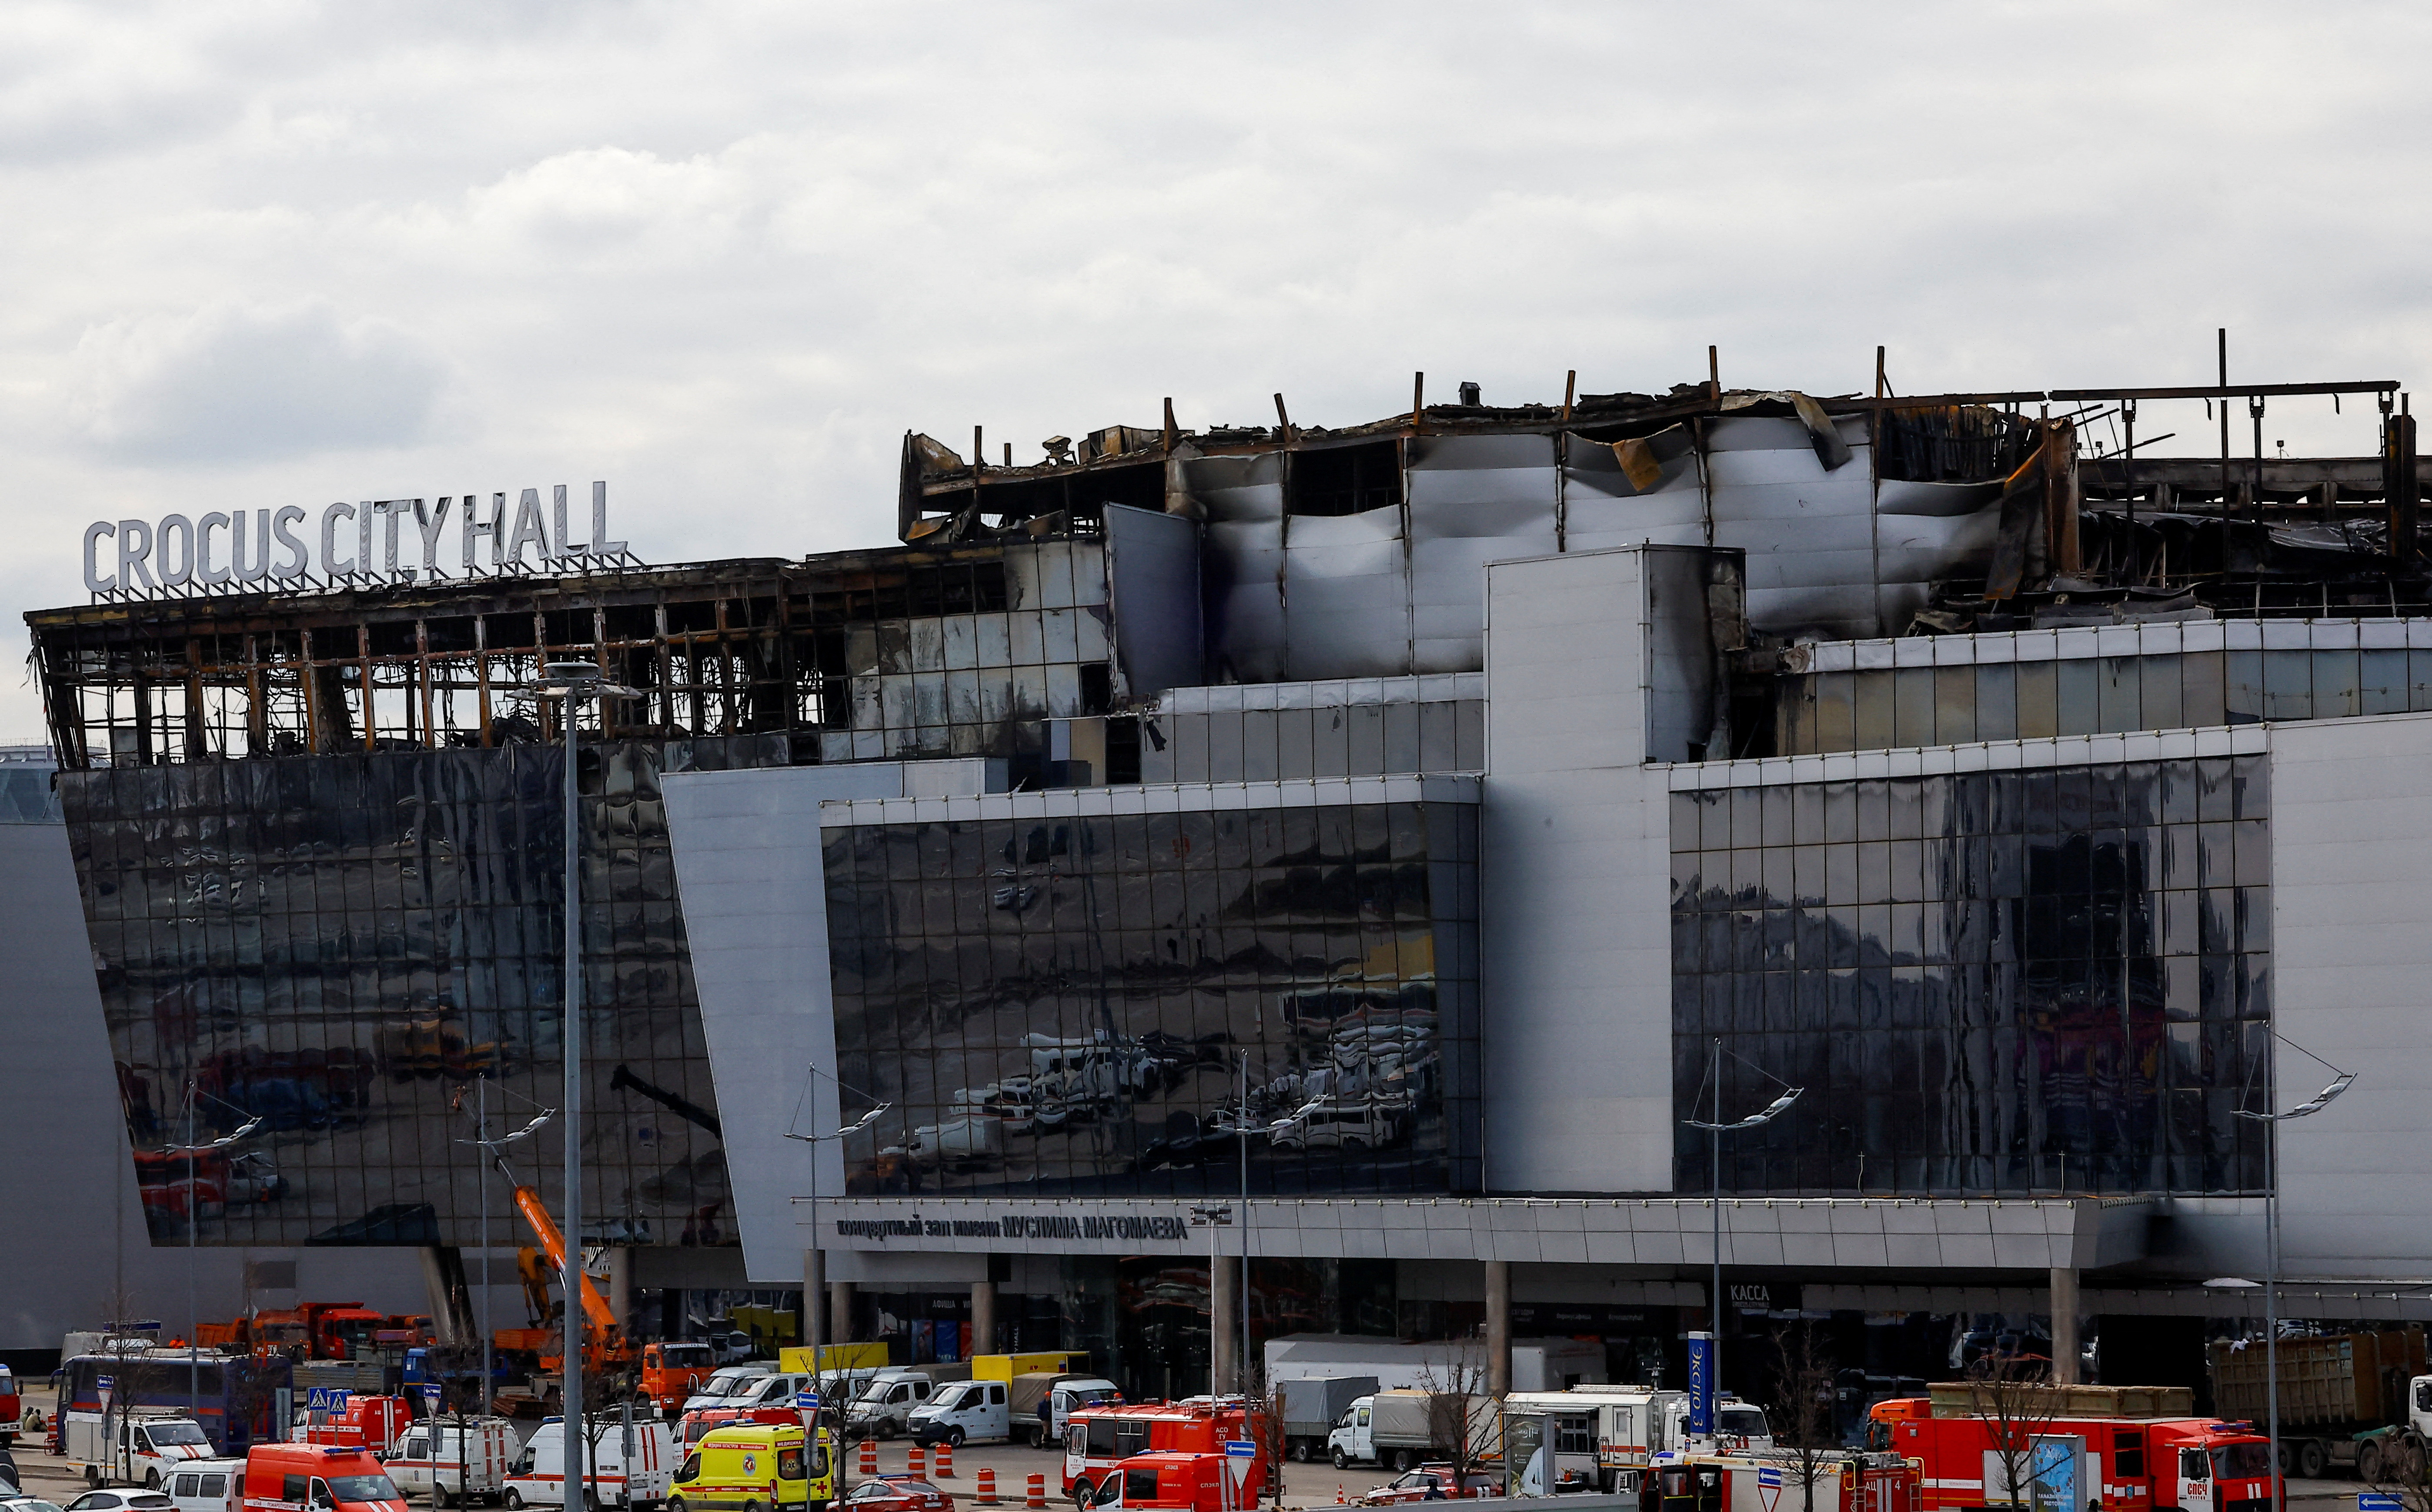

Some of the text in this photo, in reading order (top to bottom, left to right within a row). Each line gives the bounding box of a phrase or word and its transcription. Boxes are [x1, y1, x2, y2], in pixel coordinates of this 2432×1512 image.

[84, 481, 628, 593] CROCUS CITY HALL
[837, 1213, 1188, 1241] концертный зал имени МУСЛИМА МАГОМАЕВА
[1730, 1285, 1770, 1301] КАССА
[1692, 1346, 1704, 1427] ЭКСПО 3
[1865, 1480, 1901, 1492] АЦ 4
[2188, 1483, 2208, 1495] СПСЧ
